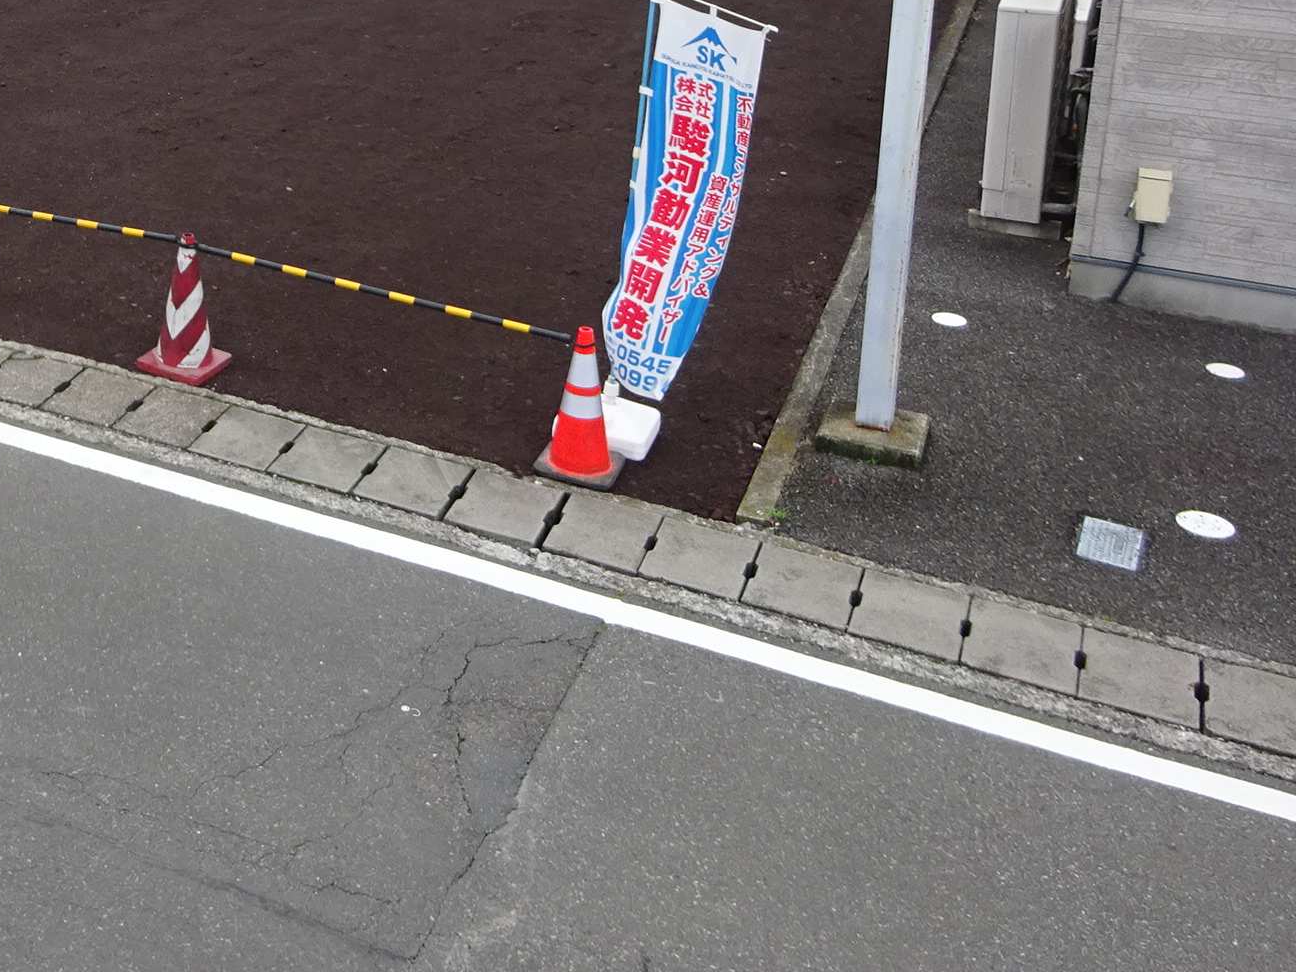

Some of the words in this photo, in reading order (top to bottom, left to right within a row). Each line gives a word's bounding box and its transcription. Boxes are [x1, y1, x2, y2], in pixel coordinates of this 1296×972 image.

[696, 45, 726, 72] SK
[611, 113, 711, 340] 駿河勧業開発
[660, 174, 728, 342] 資産運用アドバイザー
[617, 344, 672, 374] 0545
